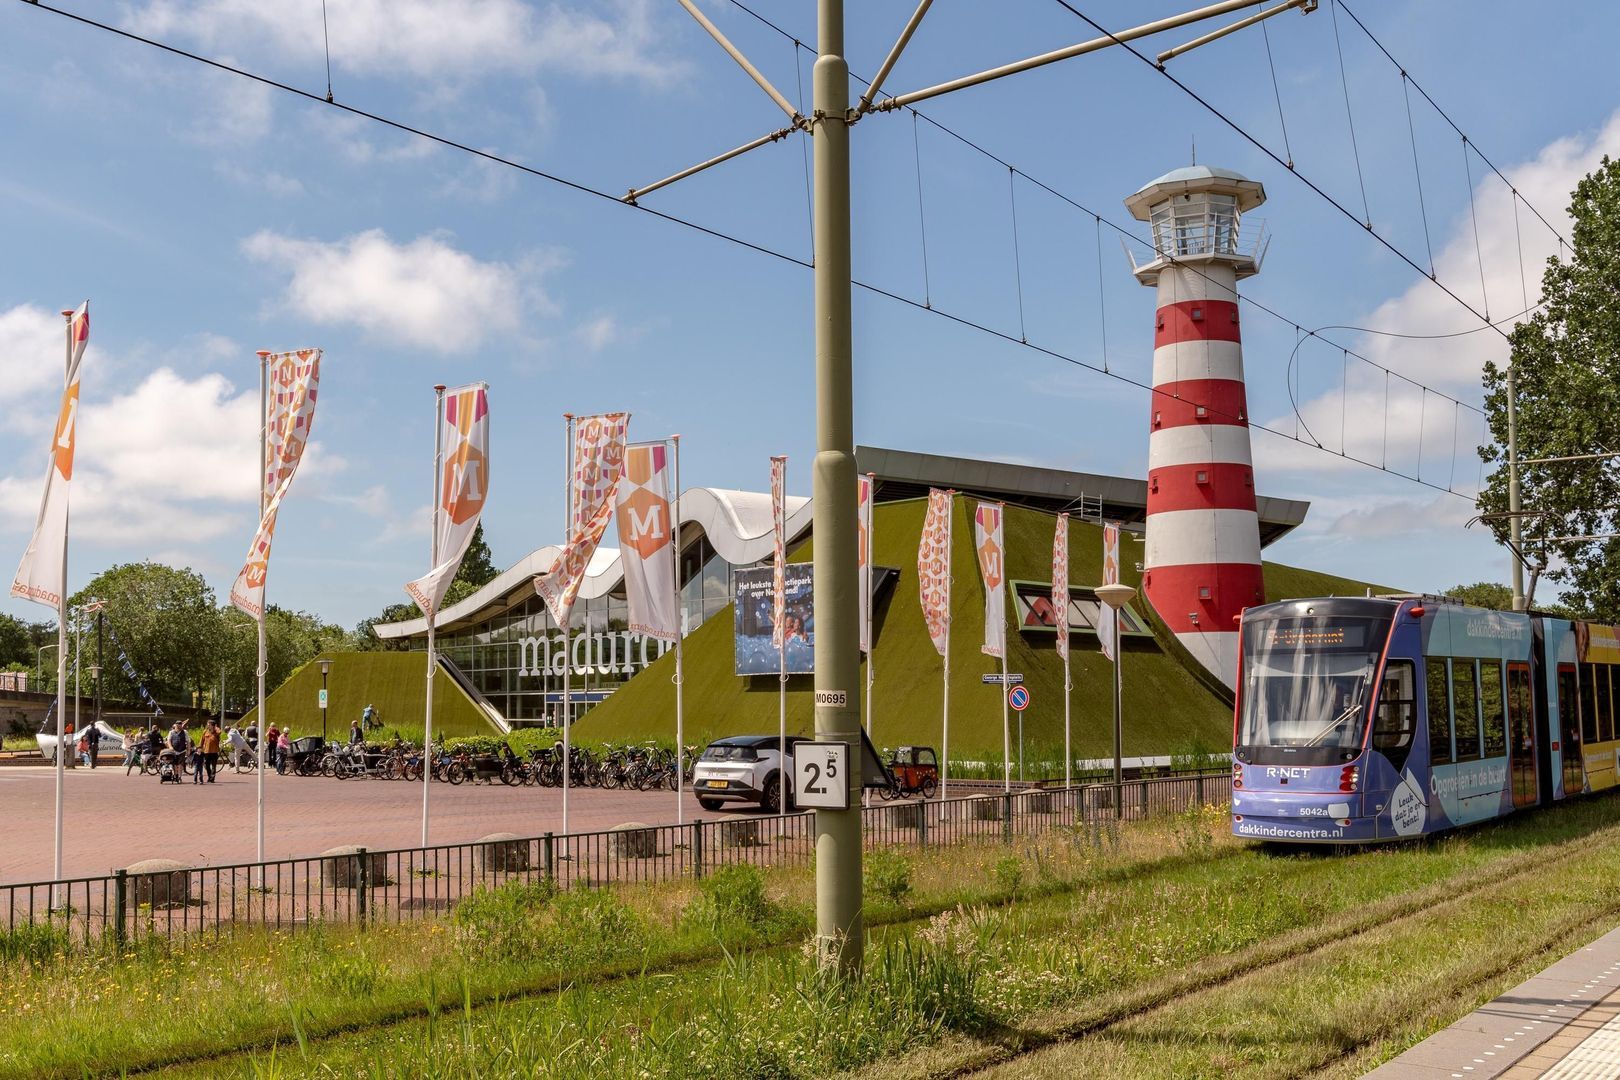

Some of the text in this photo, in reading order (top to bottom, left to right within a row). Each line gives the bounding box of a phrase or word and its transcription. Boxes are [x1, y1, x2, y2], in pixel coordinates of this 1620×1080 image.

[607, 447, 621, 459] M
[450, 460, 482, 503] M
[628, 505, 663, 541] M
[247, 565, 266, 583] M
[739, 582, 749, 590] Het
[751, 581, 771, 589] leukste
[751, 590, 764, 599] over
[816, 693, 845, 704] M0695
[1431, 765, 1506, 797] Opgroeien in de buurt
[1399, 792, 1414, 808] Leuk
[1300, 808, 1328, 816] 5042a
[1395, 809, 1407, 821] dat
[1403, 811, 1420, 828] bent!
[1239, 824, 1344, 838] dakkindercentra.nl
